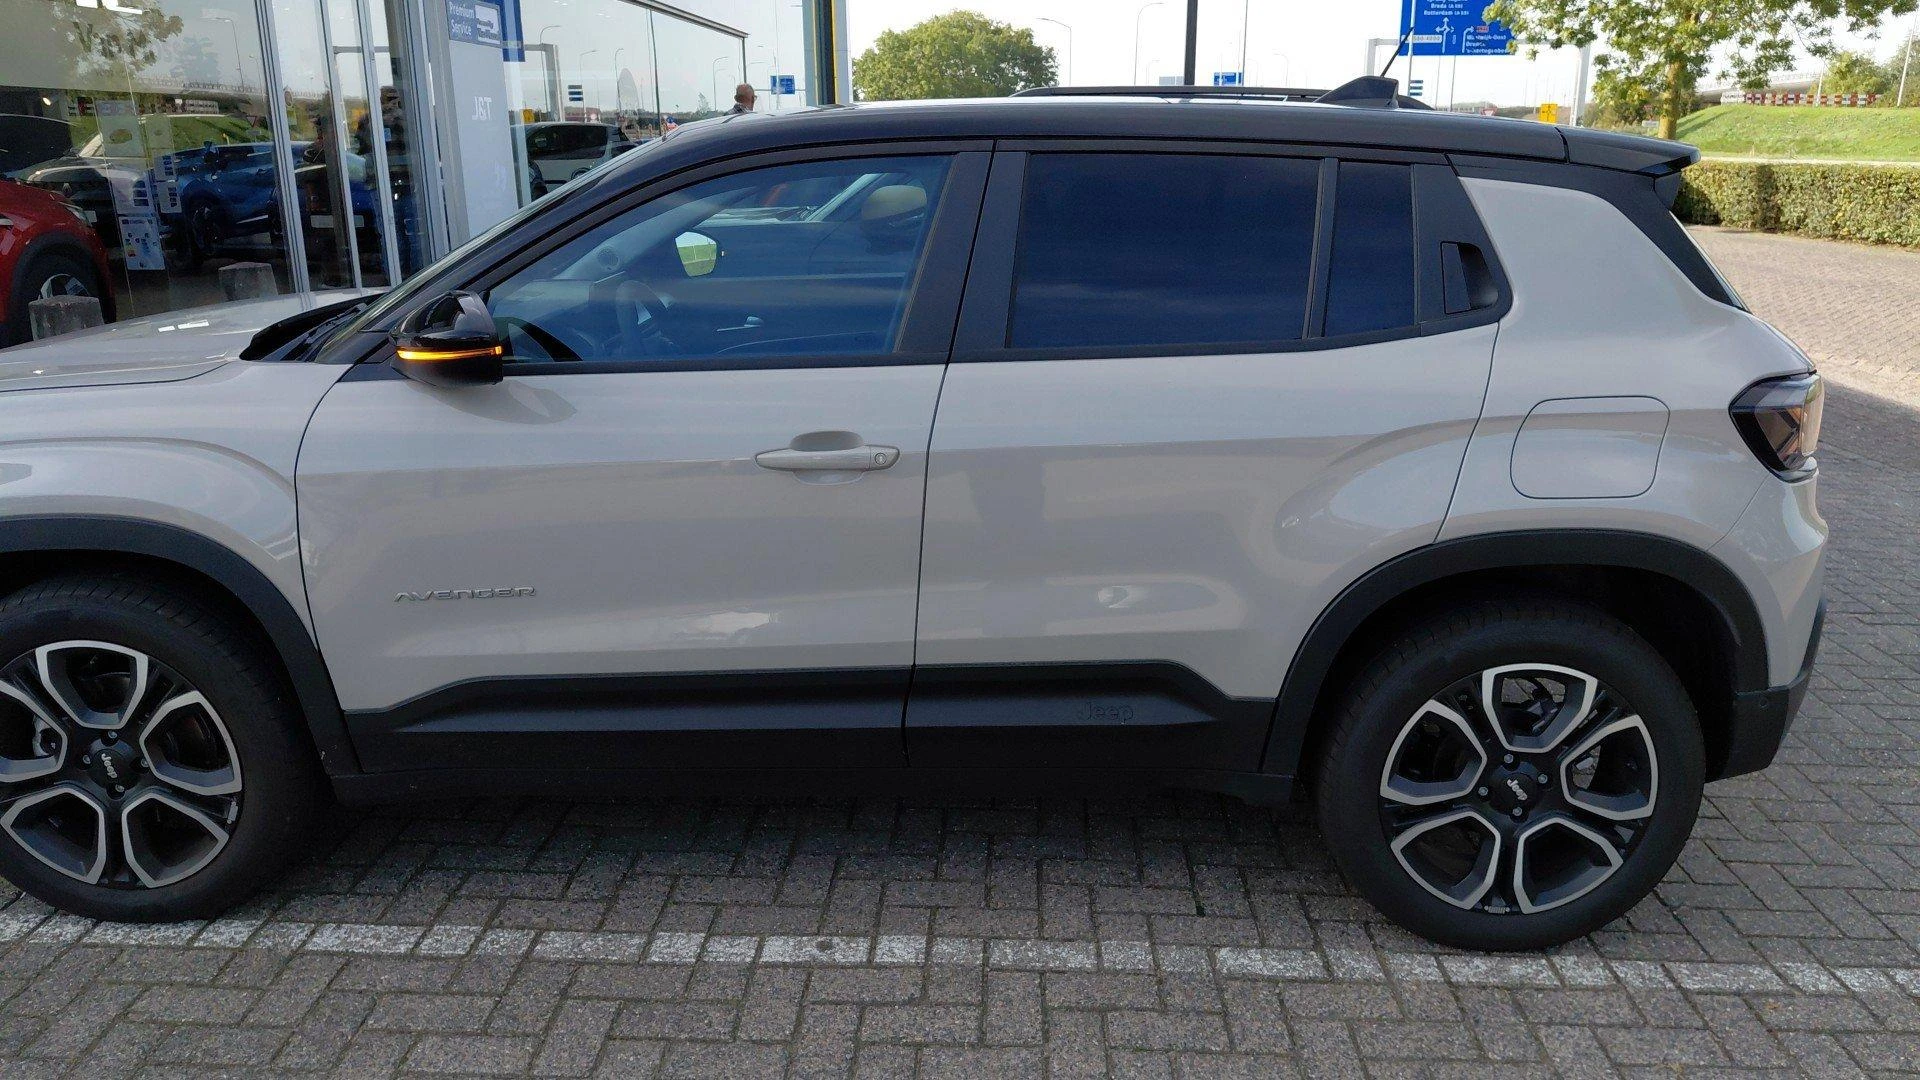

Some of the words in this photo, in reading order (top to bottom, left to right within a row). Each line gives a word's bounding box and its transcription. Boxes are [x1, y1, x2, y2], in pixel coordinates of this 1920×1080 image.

[449, 1, 475, 19] Premium
[450, 18, 472, 36] Service
[394, 586, 536, 602] AVENGER
[1079, 700, 1134, 725] Jeep
[101, 752, 118, 779] Jeep
[1506, 779, 1528, 801] Jeep
